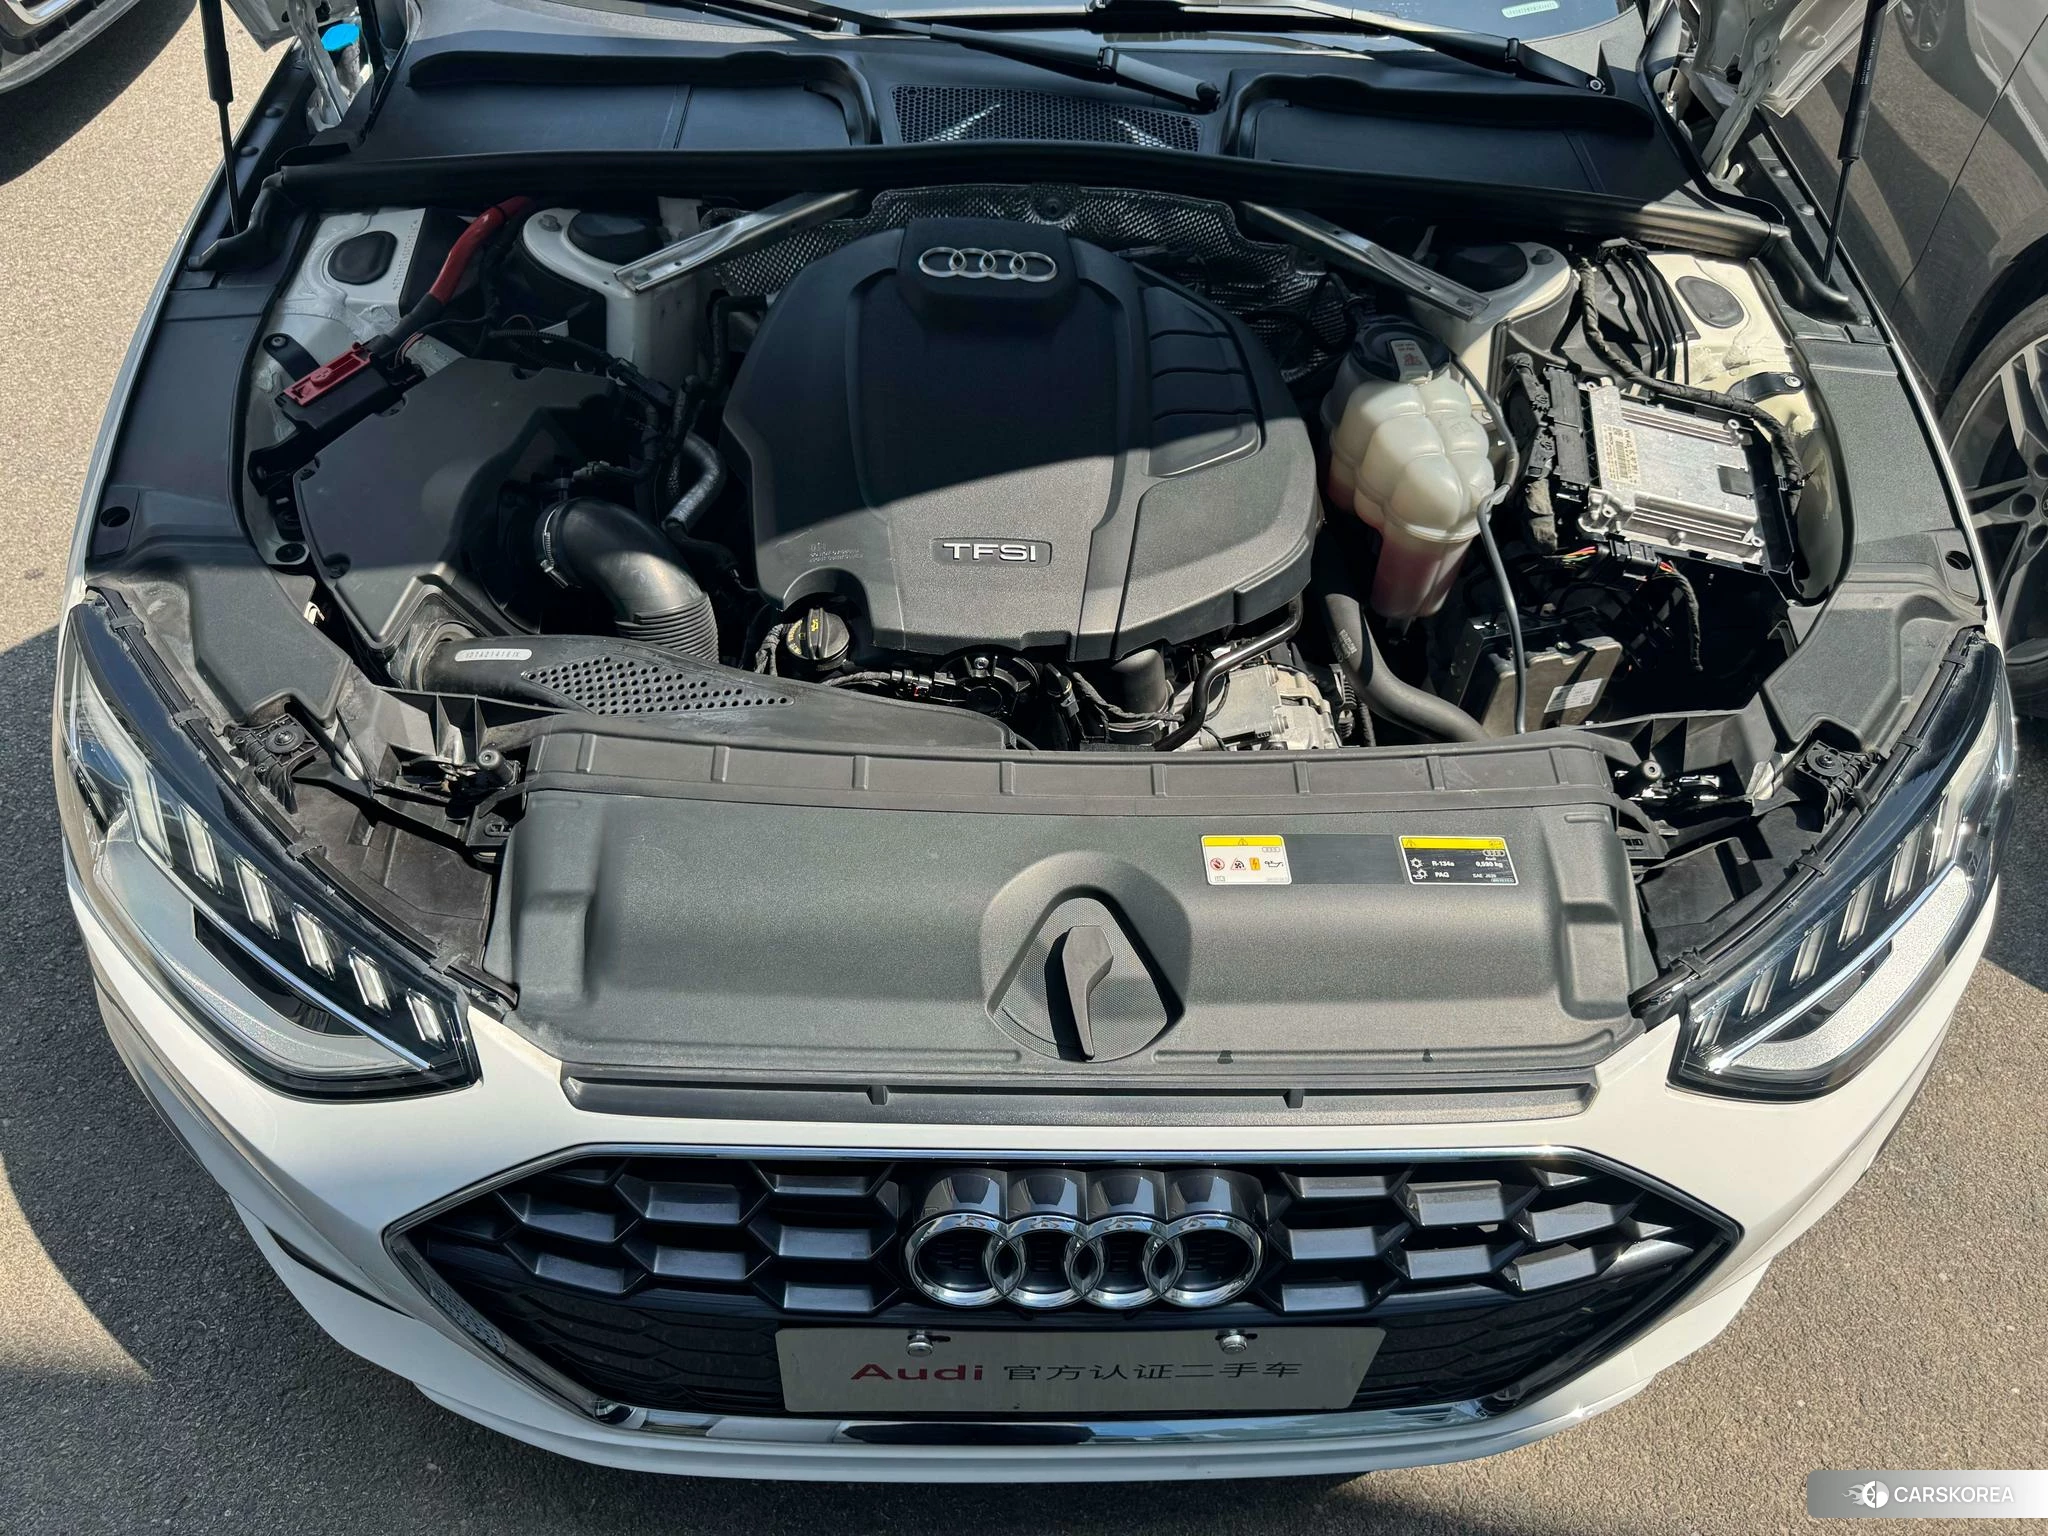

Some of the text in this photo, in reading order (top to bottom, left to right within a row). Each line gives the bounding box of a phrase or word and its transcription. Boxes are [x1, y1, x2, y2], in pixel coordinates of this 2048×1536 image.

[942, 543, 1036, 562] TFSI
[850, 1361, 1303, 1381] Audi 官方认证二手车
